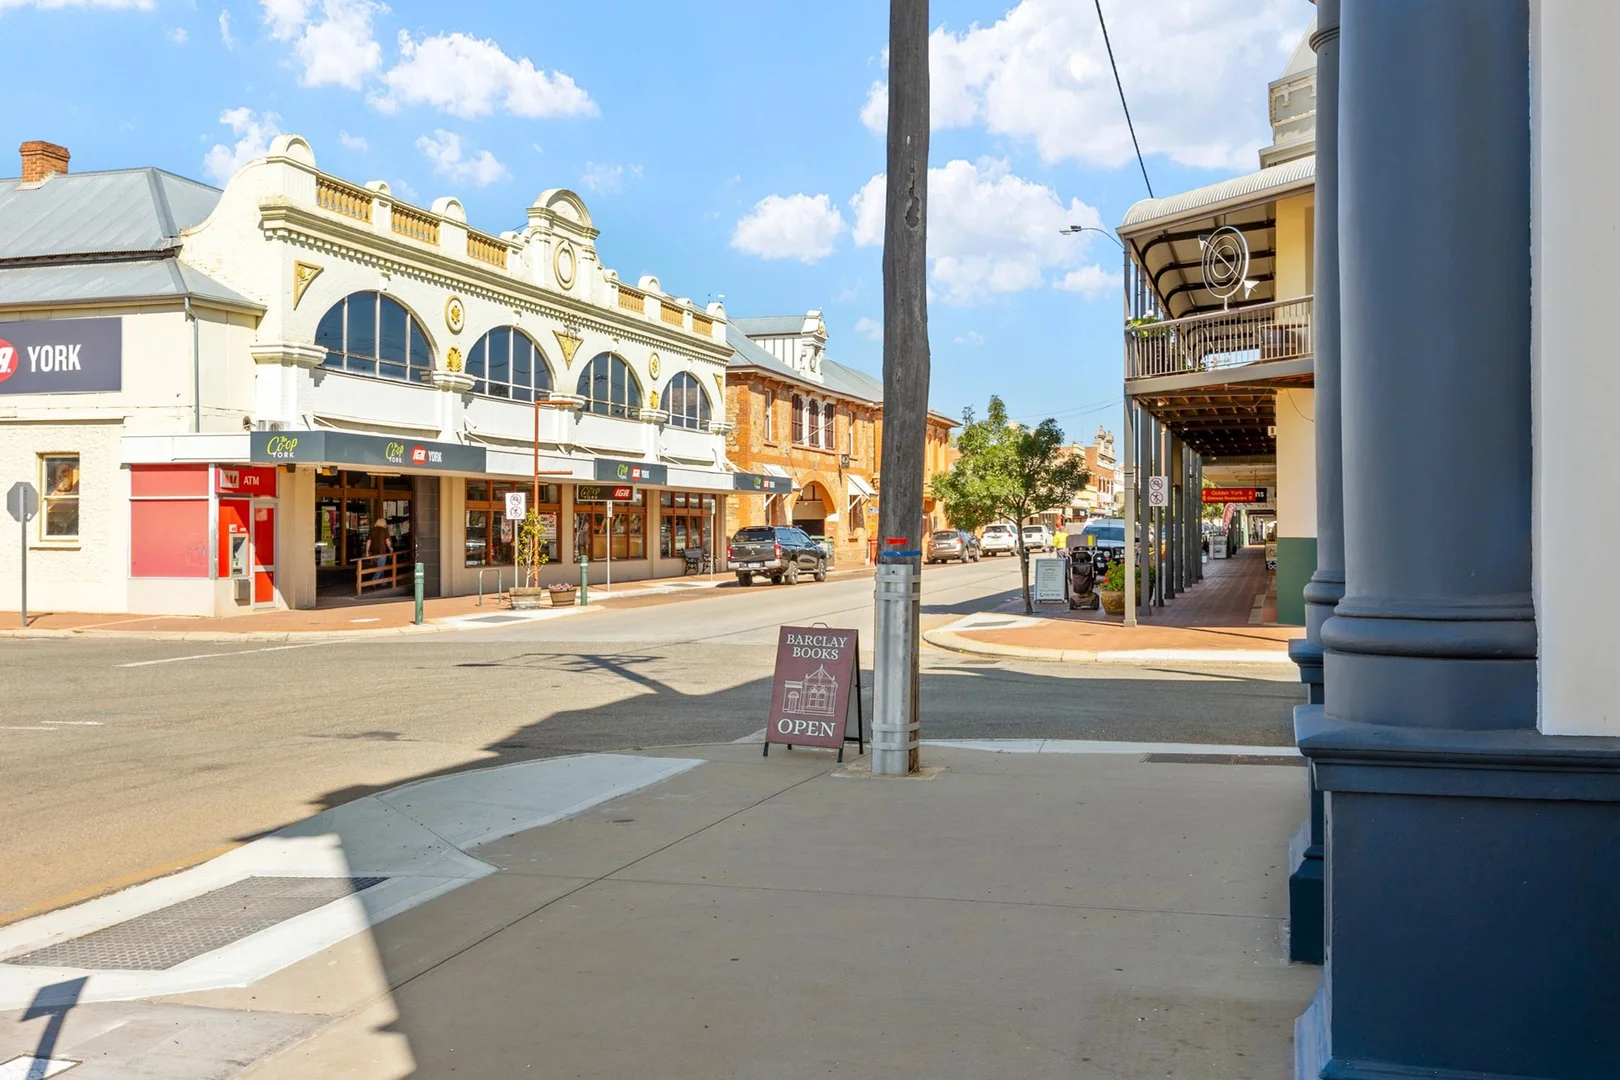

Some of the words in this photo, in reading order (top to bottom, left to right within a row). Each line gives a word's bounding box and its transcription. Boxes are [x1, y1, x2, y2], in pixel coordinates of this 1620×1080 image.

[27, 344, 82, 372] YORK
[412, 449, 426, 461] IGA
[428, 451, 442, 463] YORK
[243, 475, 260, 486] ATM
[615, 488, 630, 497] IGA
[1223, 504, 1235, 530] OPEN
[786, 633, 848, 648] BARCLAY
[792, 647, 839, 660] BOOKS
[777, 718, 836, 737] OPEN
